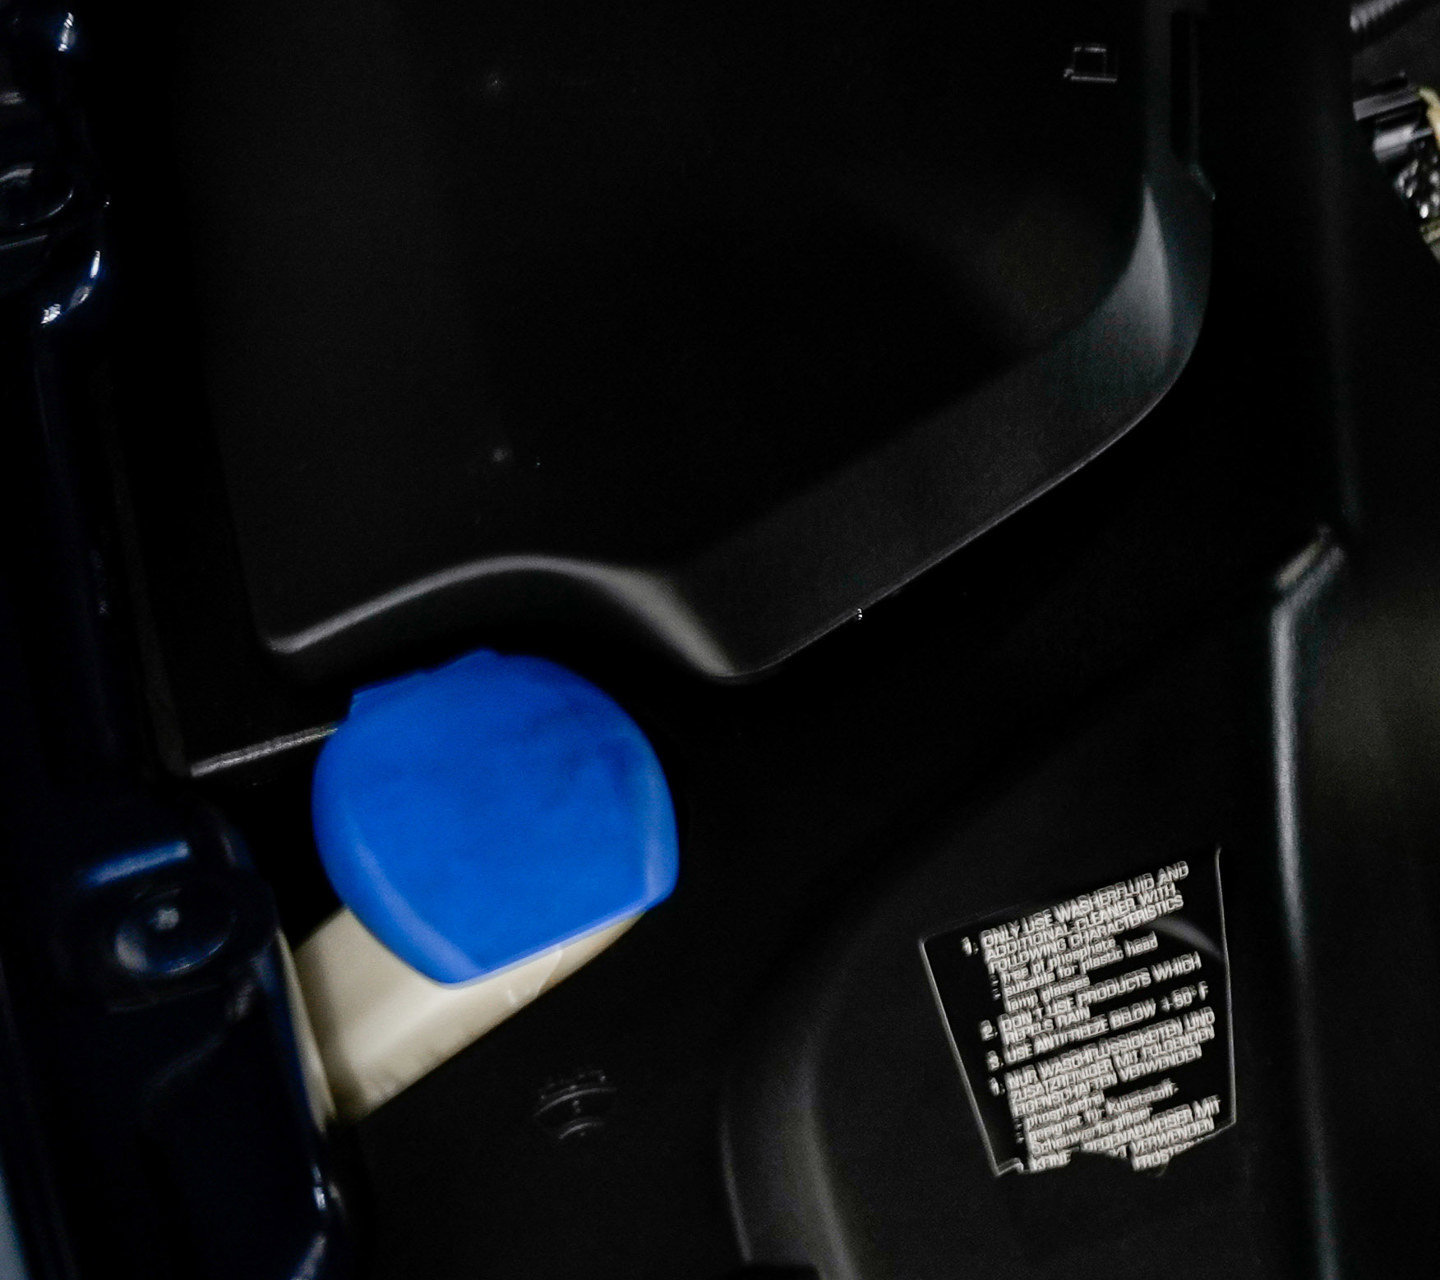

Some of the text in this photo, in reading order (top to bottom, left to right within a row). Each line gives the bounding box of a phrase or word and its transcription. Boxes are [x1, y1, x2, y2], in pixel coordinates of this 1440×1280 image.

[980, 921, 1021, 949] ONLY
[1021, 908, 1052, 936] USE
[1156, 860, 1189, 886] AND
[1138, 881, 1177, 908] WITH
[1151, 950, 1202, 983] WHICH
